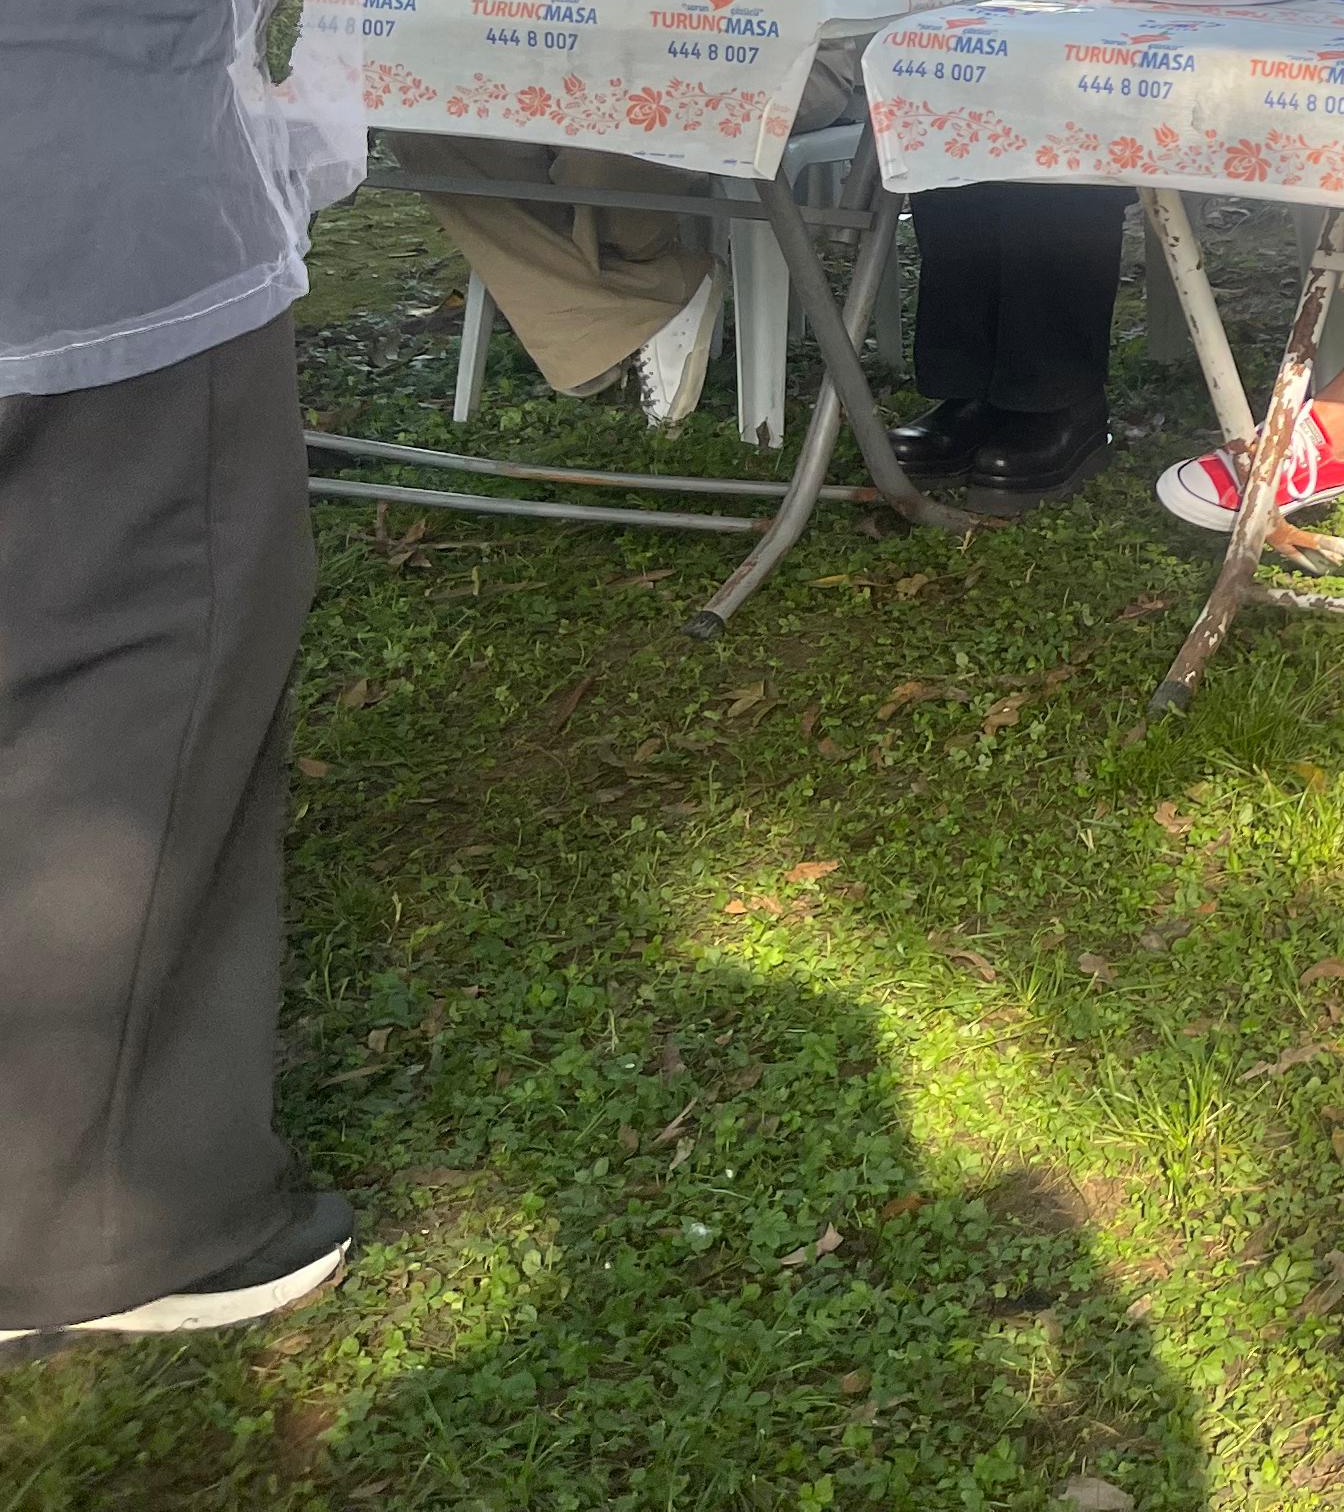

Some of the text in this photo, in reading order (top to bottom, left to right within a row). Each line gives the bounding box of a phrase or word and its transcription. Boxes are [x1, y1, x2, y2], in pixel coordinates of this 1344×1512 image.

[472, 0, 598, 25] TURUNÇMASA
[650, 10, 780, 38] TURUNÇMASA
[345, 16, 356, 35] 8
[362, 19, 396, 37] 007
[486, 28, 579, 51] 444 8 007
[882, 32, 1009, 57] TURUNÇMASA
[667, 40, 760, 65] 444 8 007
[1064, 44, 1196, 72] TURUNÇMASA
[892, 59, 987, 84] 444 8 007
[1078, 75, 1174, 100] 444 8 007
[1264, 90, 1299, 111] 444
[1306, 94, 1317, 113] 8
